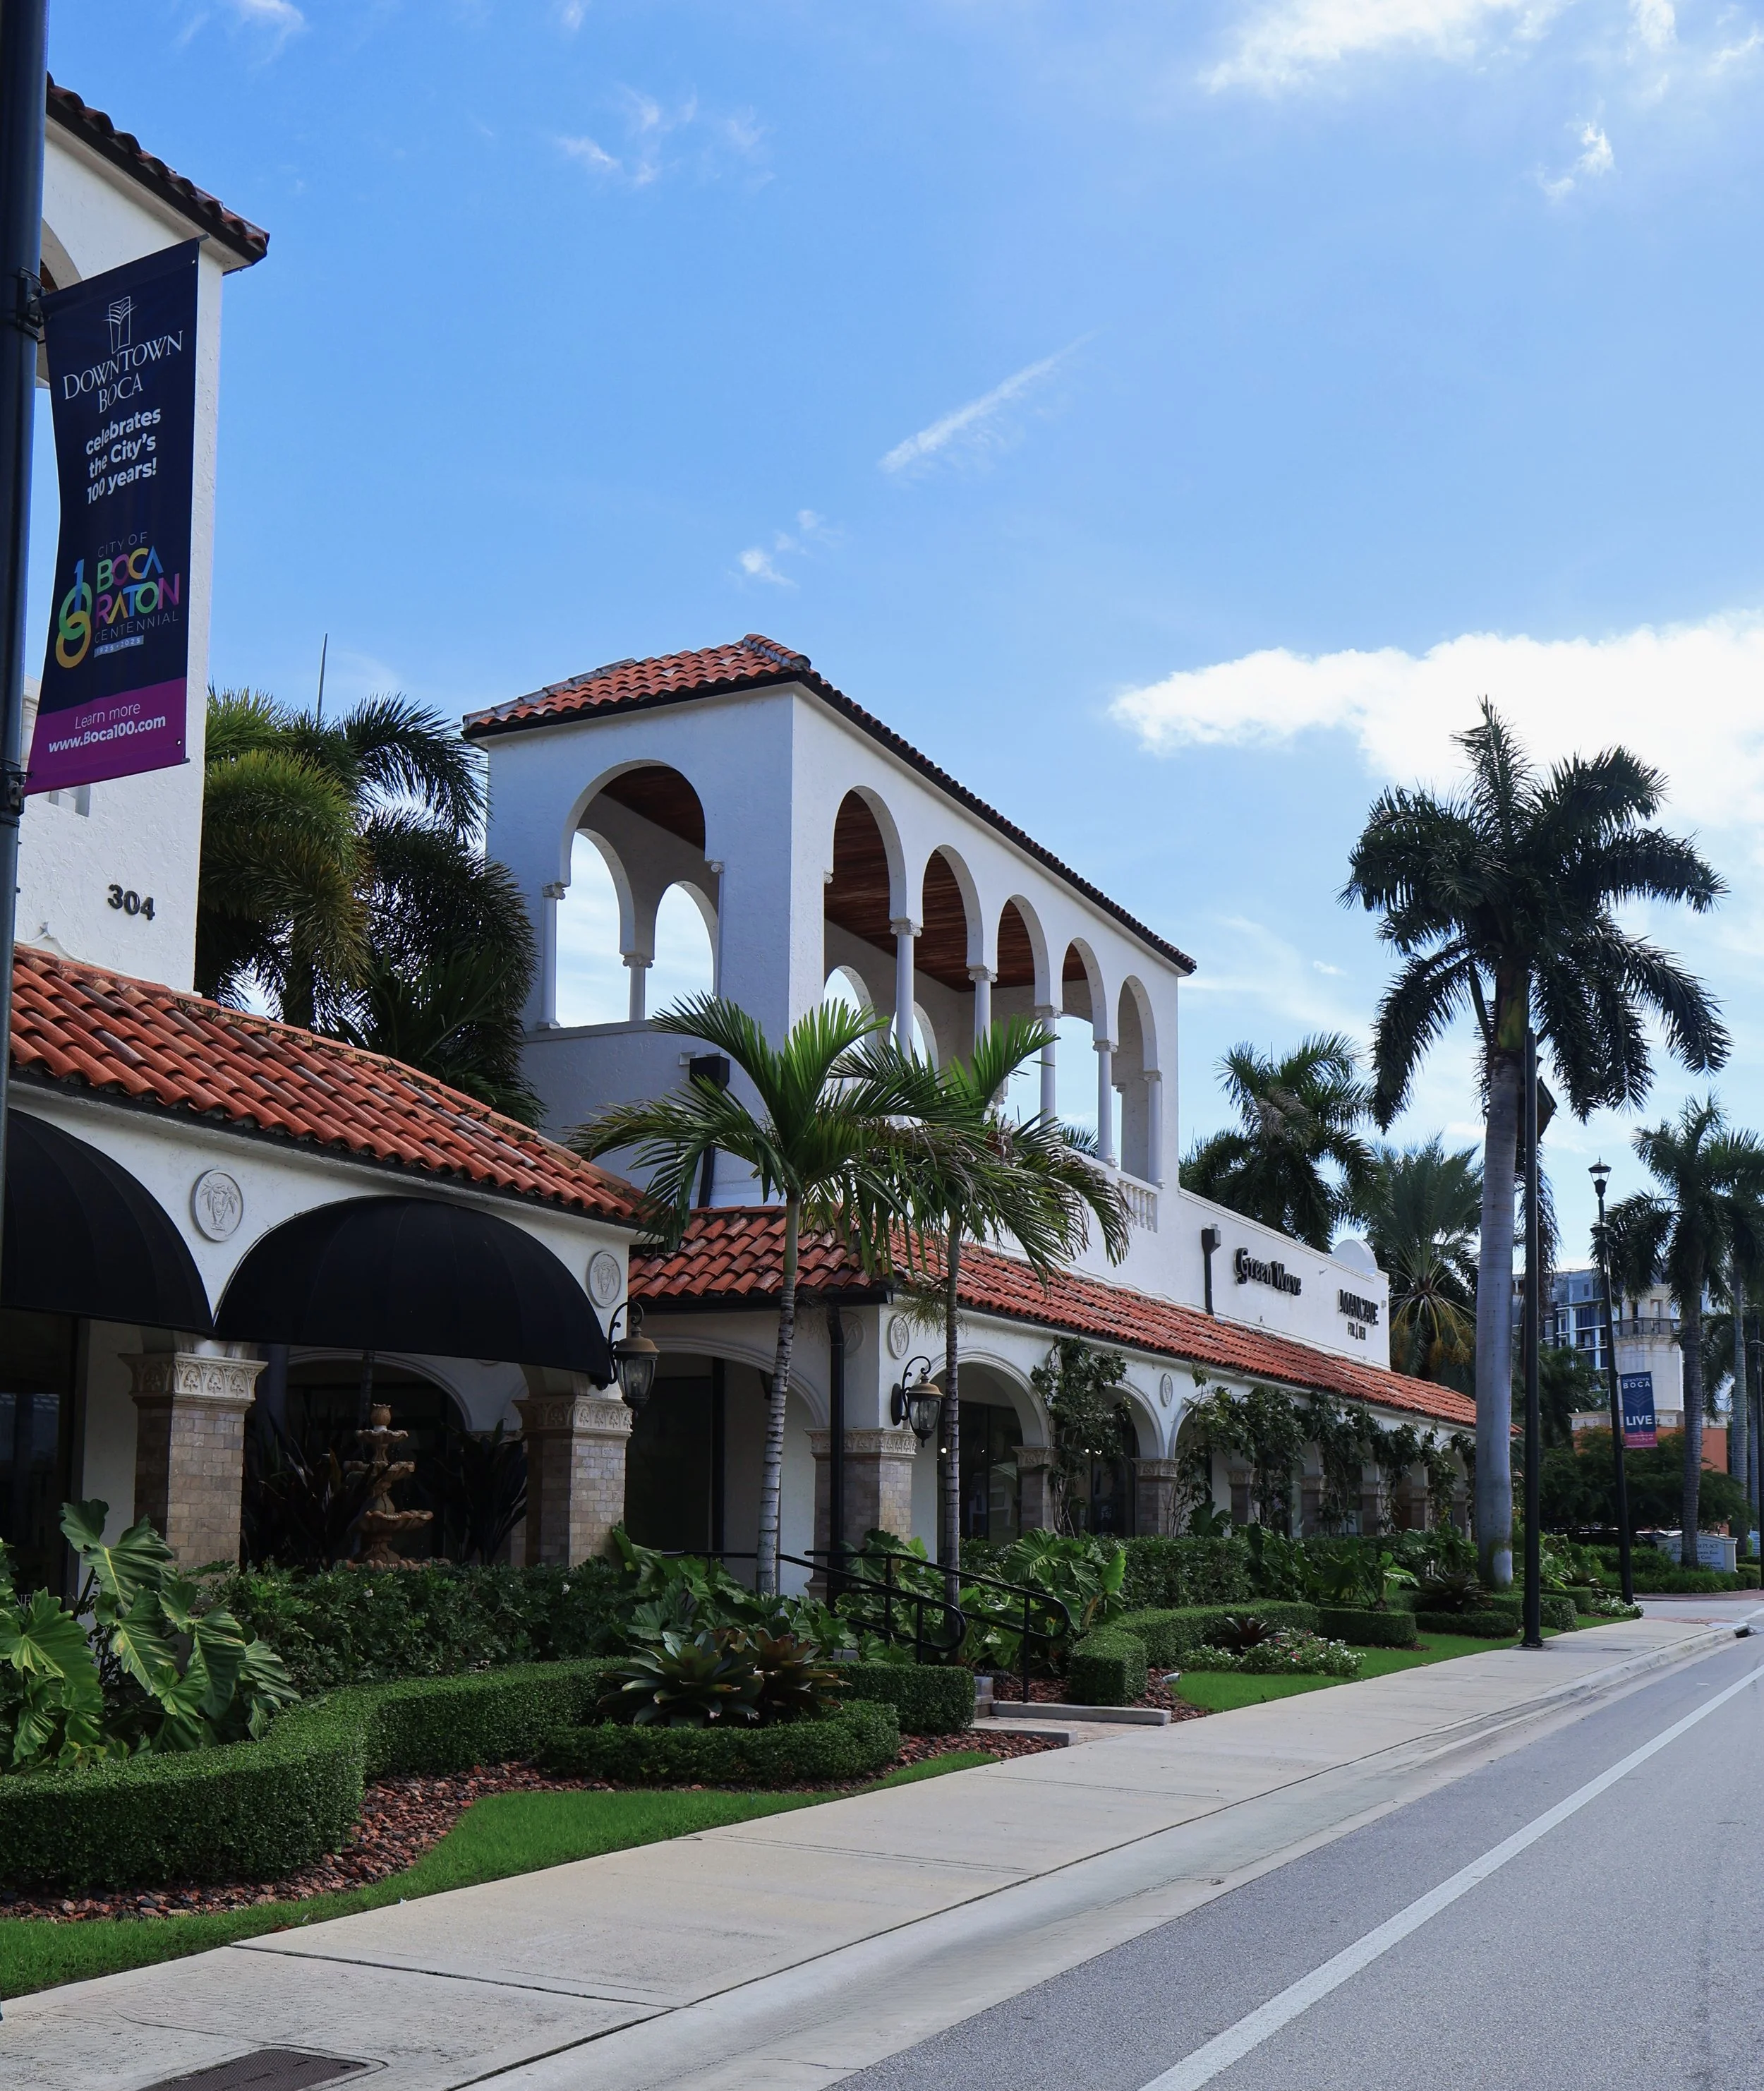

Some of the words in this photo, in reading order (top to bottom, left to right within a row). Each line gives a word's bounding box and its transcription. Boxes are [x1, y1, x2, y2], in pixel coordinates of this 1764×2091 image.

[63, 330, 183, 400] DOWNTOWN
[98, 372, 143, 414] BOCA
[85, 407, 162, 455] celebrates
[89, 454, 107, 479] the
[110, 433, 156, 463] City's
[87, 478, 105, 505] 100
[107, 457, 157, 495] years!
[97, 538, 125, 558] CITY
[128, 531, 148, 546] OF
[97, 546, 164, 594] BOCA
[96, 573, 180, 628] RATON
[94, 613, 179, 644] CENTENNIAL
[48, 714, 167, 753] www.Boca100.com
[75, 709, 106, 730] Learn
[109, 702, 141, 722] more
[107, 884, 155, 921] 304
[1236, 1247, 1272, 1284] Green
[1271, 1260, 1302, 1296] Wave
[1623, 1380, 1650, 1389] BOCA
[1626, 1415, 1653, 1426] LIVE
